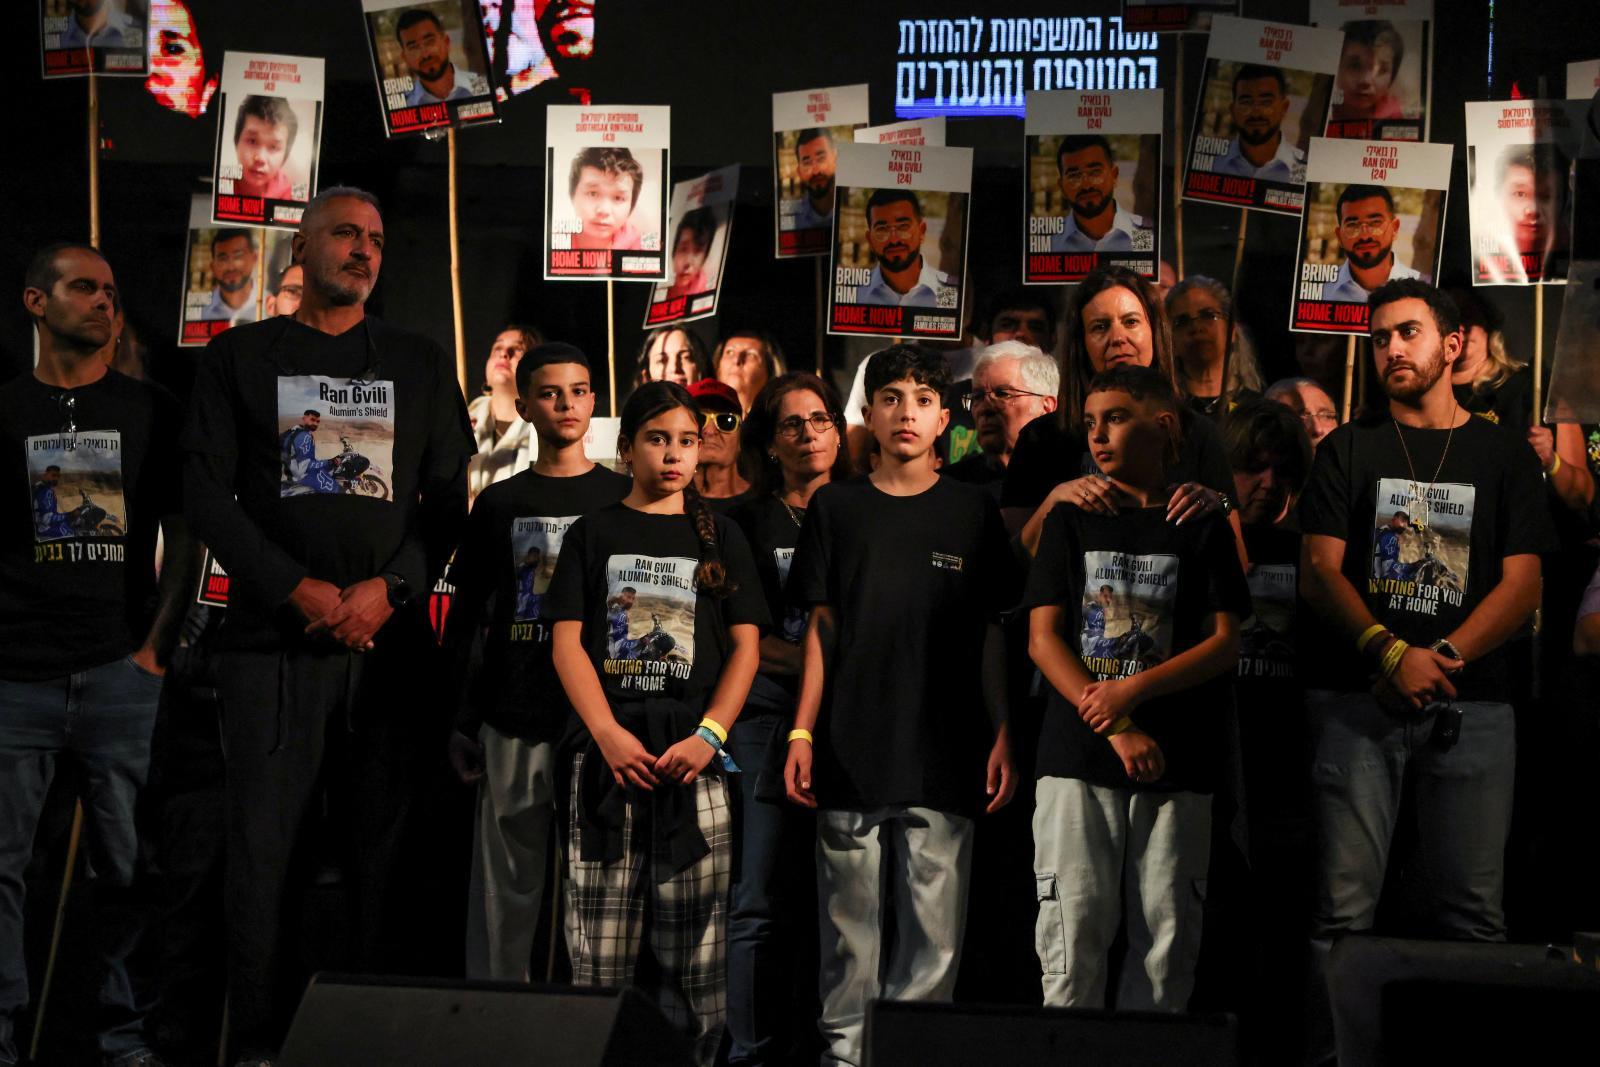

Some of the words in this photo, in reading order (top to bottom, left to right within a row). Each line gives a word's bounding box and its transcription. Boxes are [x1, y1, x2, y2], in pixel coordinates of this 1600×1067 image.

[897, 15, 983, 54] להחזרת
[989, 16, 1101, 52] המשפחות
[896, 58, 1023, 106] והנעדרים
[1032, 56, 1157, 90] החטופים
[384, 76, 414, 95] BRING
[386, 93, 407, 110] HIM
[390, 108, 419, 126] HOME
[419, 101, 449, 121] NOW!
[1077, 106, 1093, 118] RAN
[1094, 106, 1112, 118] GVILI
[1086, 119, 1102, 130] (24)
[1194, 135, 1229, 156] BRING
[888, 160, 904, 172] RAN
[904, 161, 922, 173] GVILI
[1191, 153, 1215, 171] HIM
[1362, 157, 1378, 168] RAN
[1379, 158, 1398, 169] GVILI
[897, 173, 912, 185] (24)
[1187, 172, 1220, 193] HOME
[1221, 177, 1256, 198] NOW!
[1371, 169, 1387, 181] (24)
[217, 194, 241, 213] HOME
[241, 196, 264, 215] NOW!
[1030, 215, 1064, 235] BRING
[552, 233, 572, 250] HIM
[1030, 235, 1051, 253] HIM
[551, 250, 580, 268] HOME
[582, 249, 613, 269] NOW!
[1029, 254, 1062, 274] HOME
[1063, 252, 1098, 274] NOW!
[836, 267, 870, 286] BRING
[1301, 262, 1339, 283] BRING
[835, 285, 857, 304] HIM
[1299, 281, 1323, 301] HIM
[833, 304, 867, 324] HOME
[869, 305, 903, 326] NOW!
[1297, 301, 1332, 321] HOME
[1334, 302, 1369, 325] NOW!
[320, 382, 348, 404] Ran
[353, 385, 387, 405] Gvili
[329, 405, 363, 417] Alumim's
[364, 407, 388, 418] Shield
[33, 438, 61, 450] עלומים
[83, 438, 108, 449] גואילי
[111, 439, 118, 450] רן
[1427, 487, 1450, 501] GVILI
[1433, 501, 1465, 516] SHIELD
[33, 542, 64, 564] בבית
[67, 541, 83, 563] לך
[87, 542, 125, 563] מחכים
[635, 558, 652, 571] RAN
[654, 562, 677, 574] GVILI
[1112, 555, 1128, 568] RAN
[1130, 560, 1154, 573] GVILI
[618, 570, 660, 586] ALUMIM'S
[660, 574, 690, 591] SHIELD
[1095, 567, 1135, 584] ALUMIM'S
[1137, 573, 1168, 587] SHIELD
[1368, 577, 1416, 597] WAITING
[1417, 582, 1440, 600] FOR
[1442, 587, 1464, 608] YOU
[1388, 593, 1404, 610] AT
[1405, 596, 1440, 616] HOME
[603, 658, 645, 676] WAITING
[645, 660, 669, 675] FOR
[670, 661, 693, 680] YOU
[1121, 659, 1143, 676] FOR
[620, 675, 637, 689] AT
[638, 675, 666, 691] HOME
